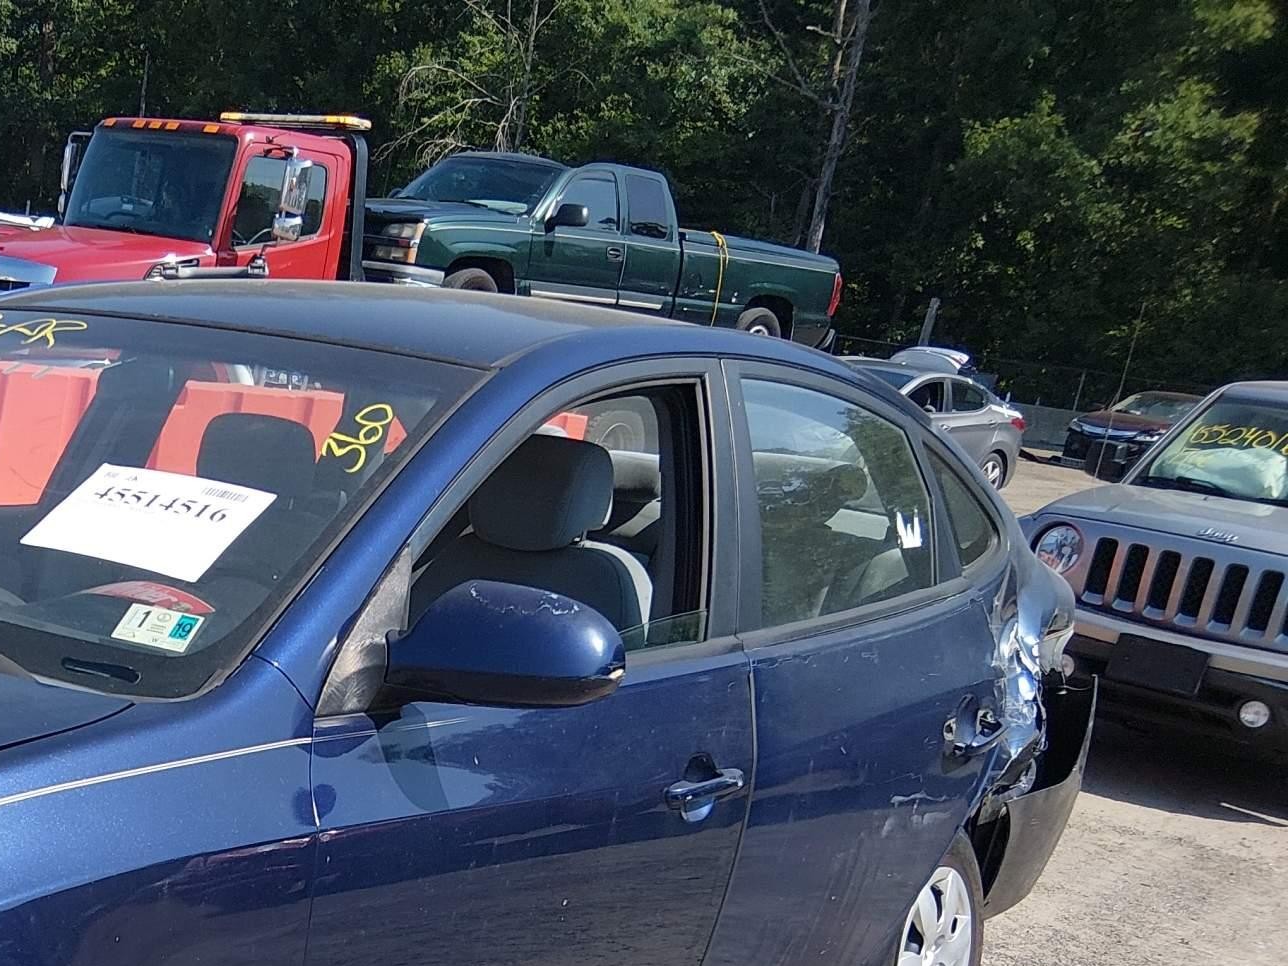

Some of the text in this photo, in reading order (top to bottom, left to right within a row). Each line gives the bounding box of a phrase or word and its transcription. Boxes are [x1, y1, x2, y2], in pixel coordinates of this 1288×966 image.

[321, 403, 393, 473] 360
[94, 486, 227, 523] 45514516
[137, 610, 152, 628] 1
[175, 621, 194, 638] 19
